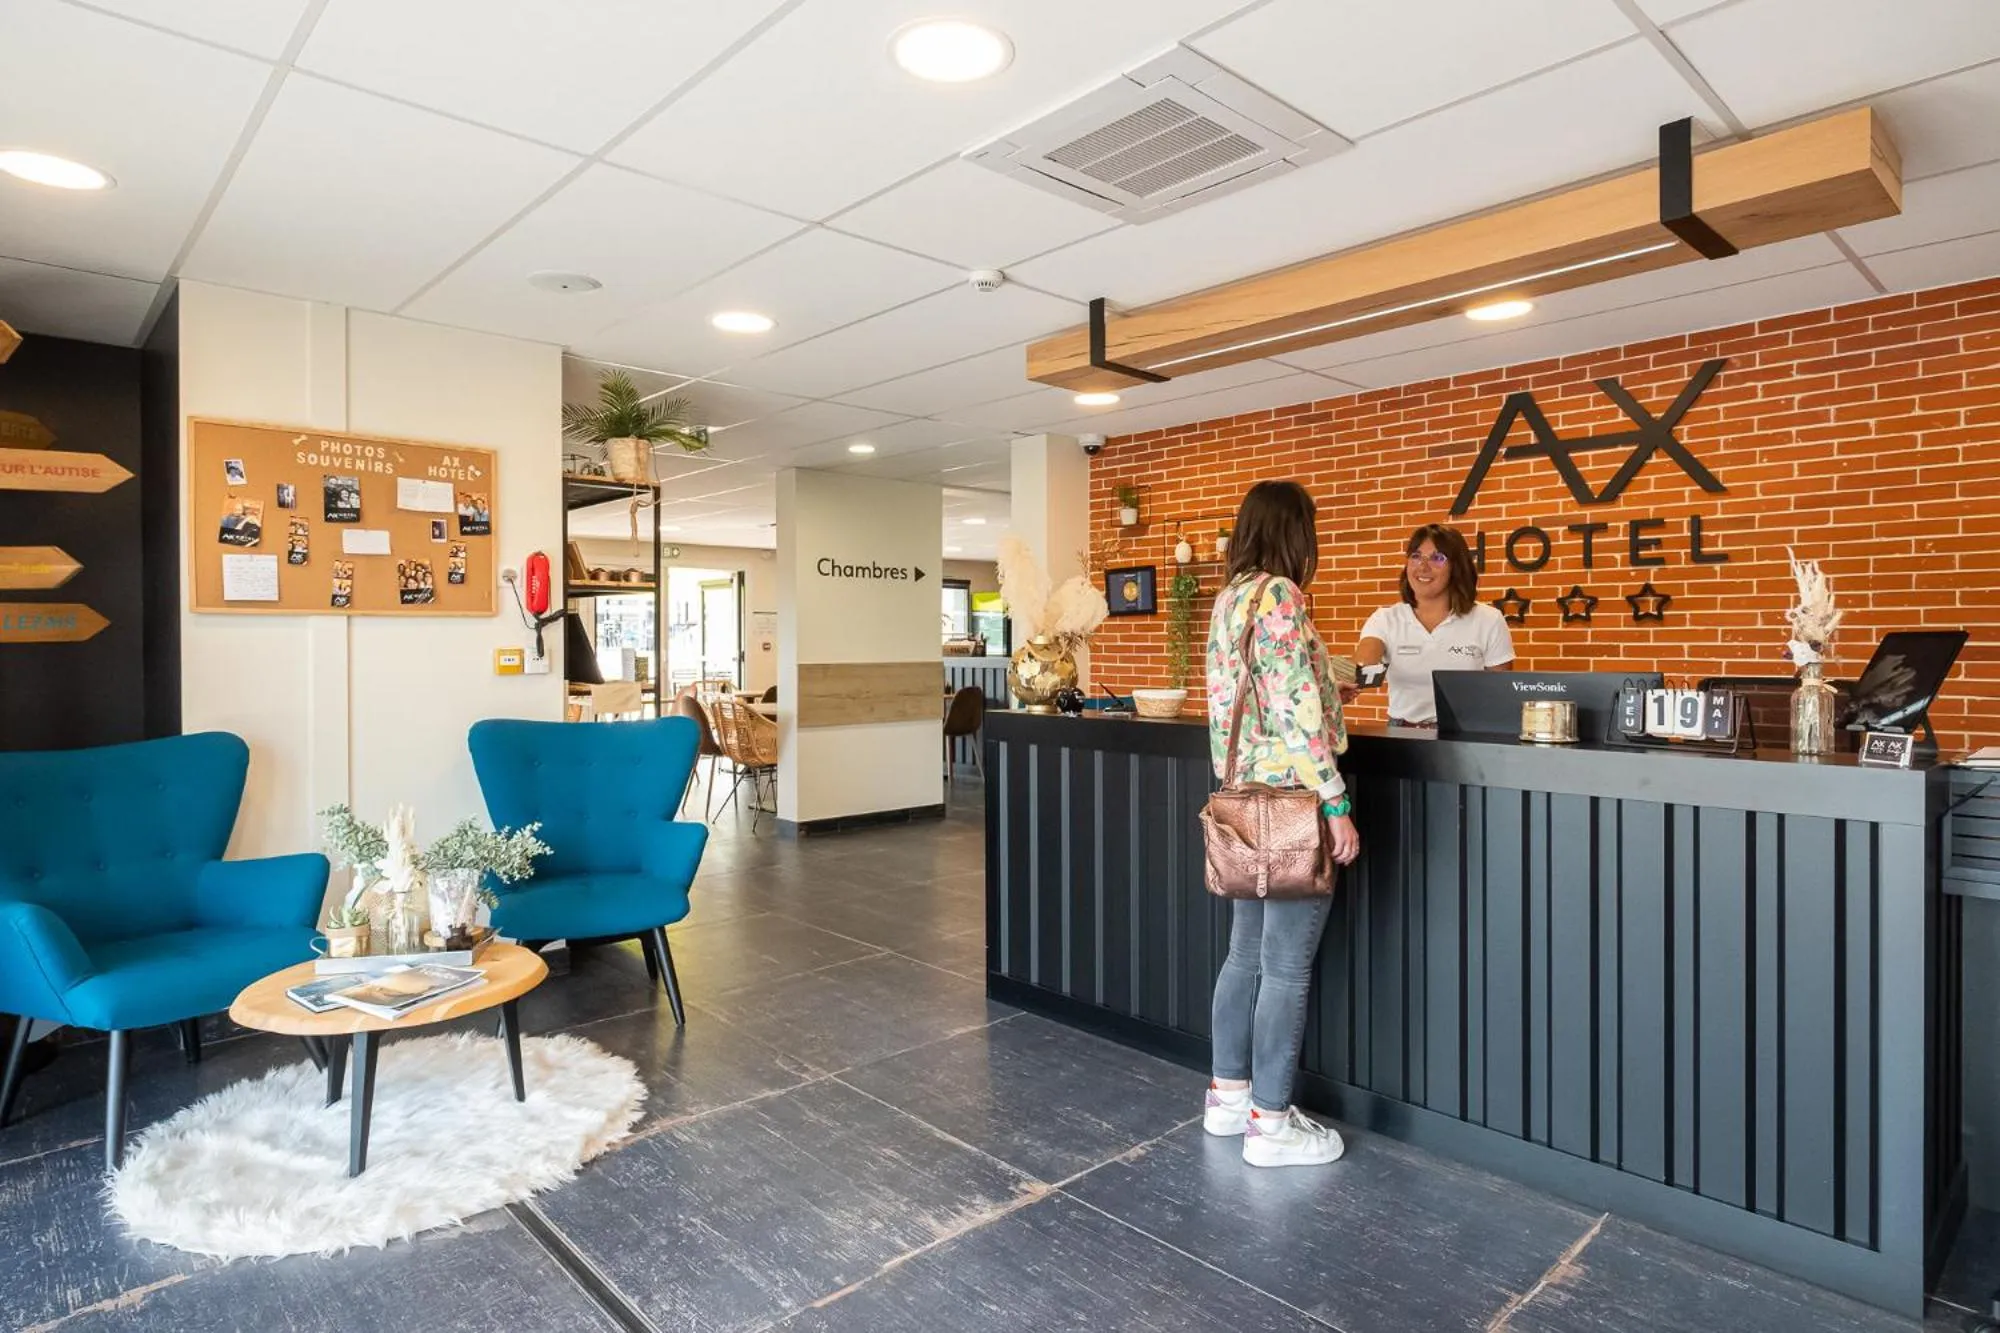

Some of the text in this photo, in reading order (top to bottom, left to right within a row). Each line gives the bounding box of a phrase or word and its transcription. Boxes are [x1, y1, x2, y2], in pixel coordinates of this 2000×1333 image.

[1449, 359, 1728, 516] AX
[320, 440, 385, 458] PHOTOS
[442, 455, 460, 467] AX
[0, 463, 101, 478] UR L'AUTISE
[428, 466, 476, 481] HOTEL
[817, 558, 908, 580] Chambres
[1512, 681, 1568, 692] ViewSonic
[1625, 695, 1724, 729] JEU 19 MAI
